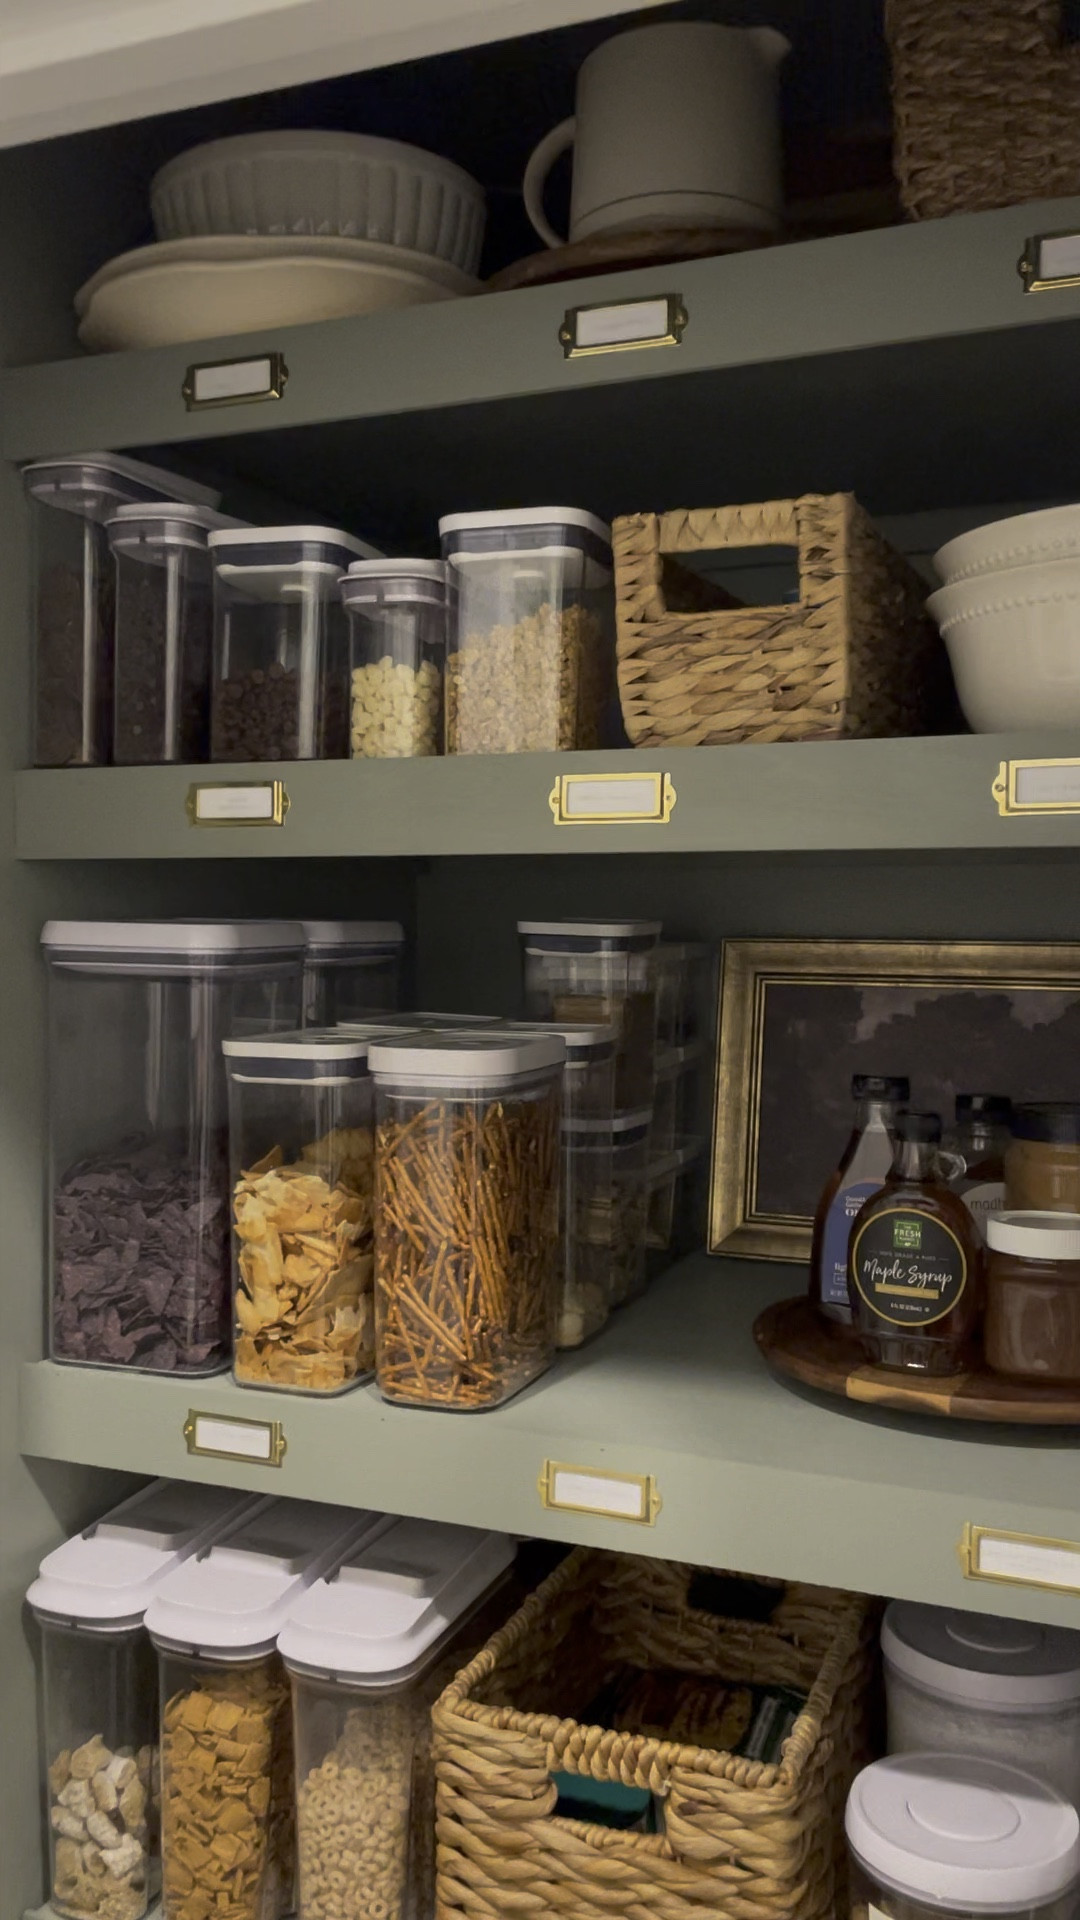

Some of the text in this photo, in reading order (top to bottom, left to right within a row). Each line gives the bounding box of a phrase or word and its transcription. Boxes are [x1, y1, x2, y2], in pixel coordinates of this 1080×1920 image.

[894, 1229, 921, 1238] FRESH
[863, 1258, 906, 1285] Maple
[907, 1265, 953, 1292] Syrup
